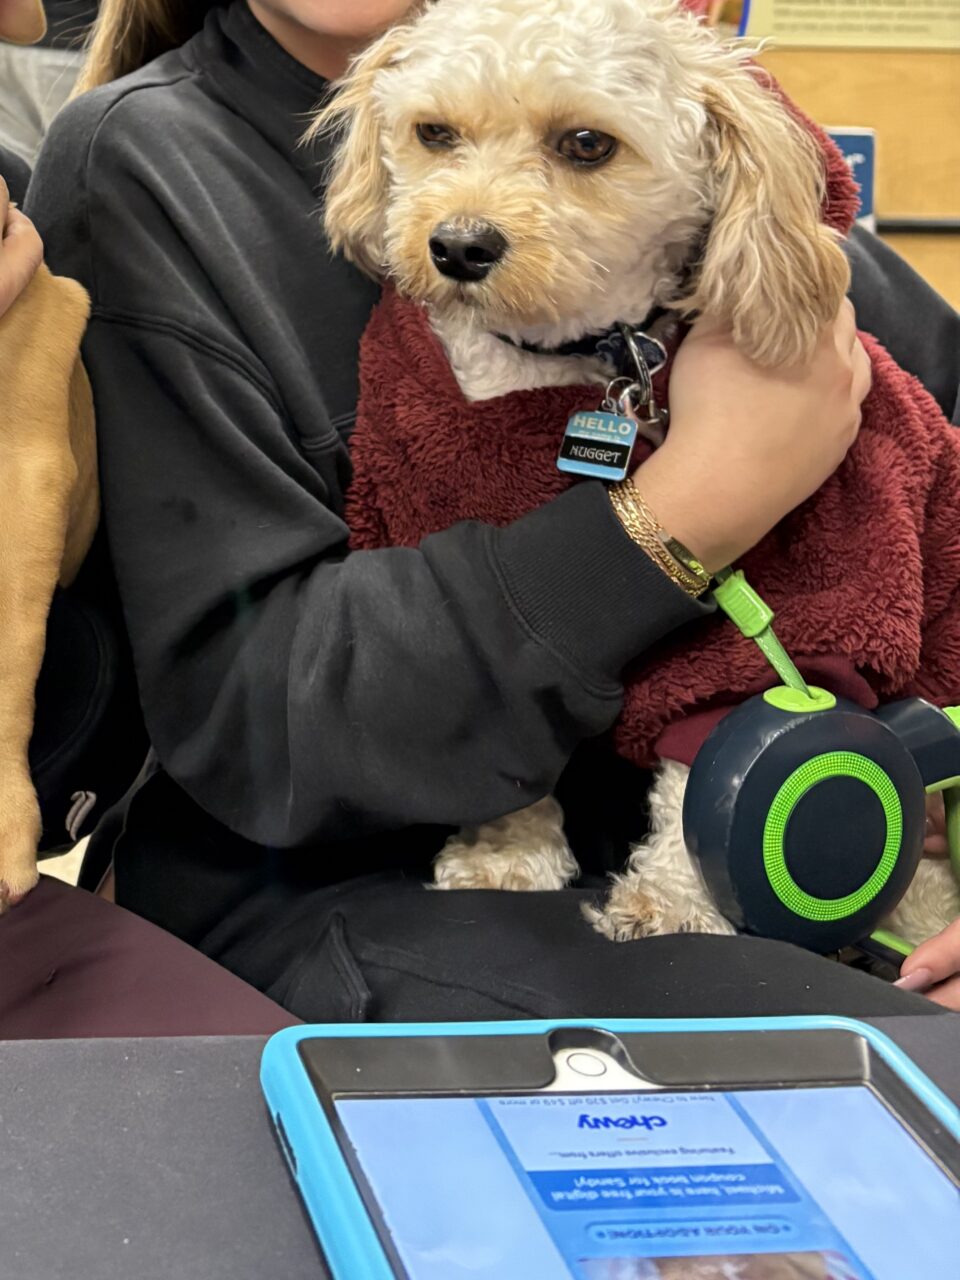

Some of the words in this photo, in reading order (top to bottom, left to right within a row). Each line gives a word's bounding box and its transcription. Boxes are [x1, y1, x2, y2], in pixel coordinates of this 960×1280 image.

[573, 415, 632, 435] HELLO
[569, 445, 621, 463] NUGGET
[543, 1097, 566, 1106] $49
[568, 1097, 583, 1105] off
[584, 1096, 607, 1105] $20
[577, 1114, 668, 1131] chewy
[589, 1149, 622, 1158] offers
[624, 1148, 677, 1157] exclusive
[679, 1146, 736, 1155] Featuring
[628, 1175, 650, 1187] for
[651, 1174, 689, 1185] book
[691, 1173, 746, 1183] coupon
[551, 1189, 599, 1202] digital
[602, 1188, 633, 1200] free
[635, 1186, 668, 1198] your
